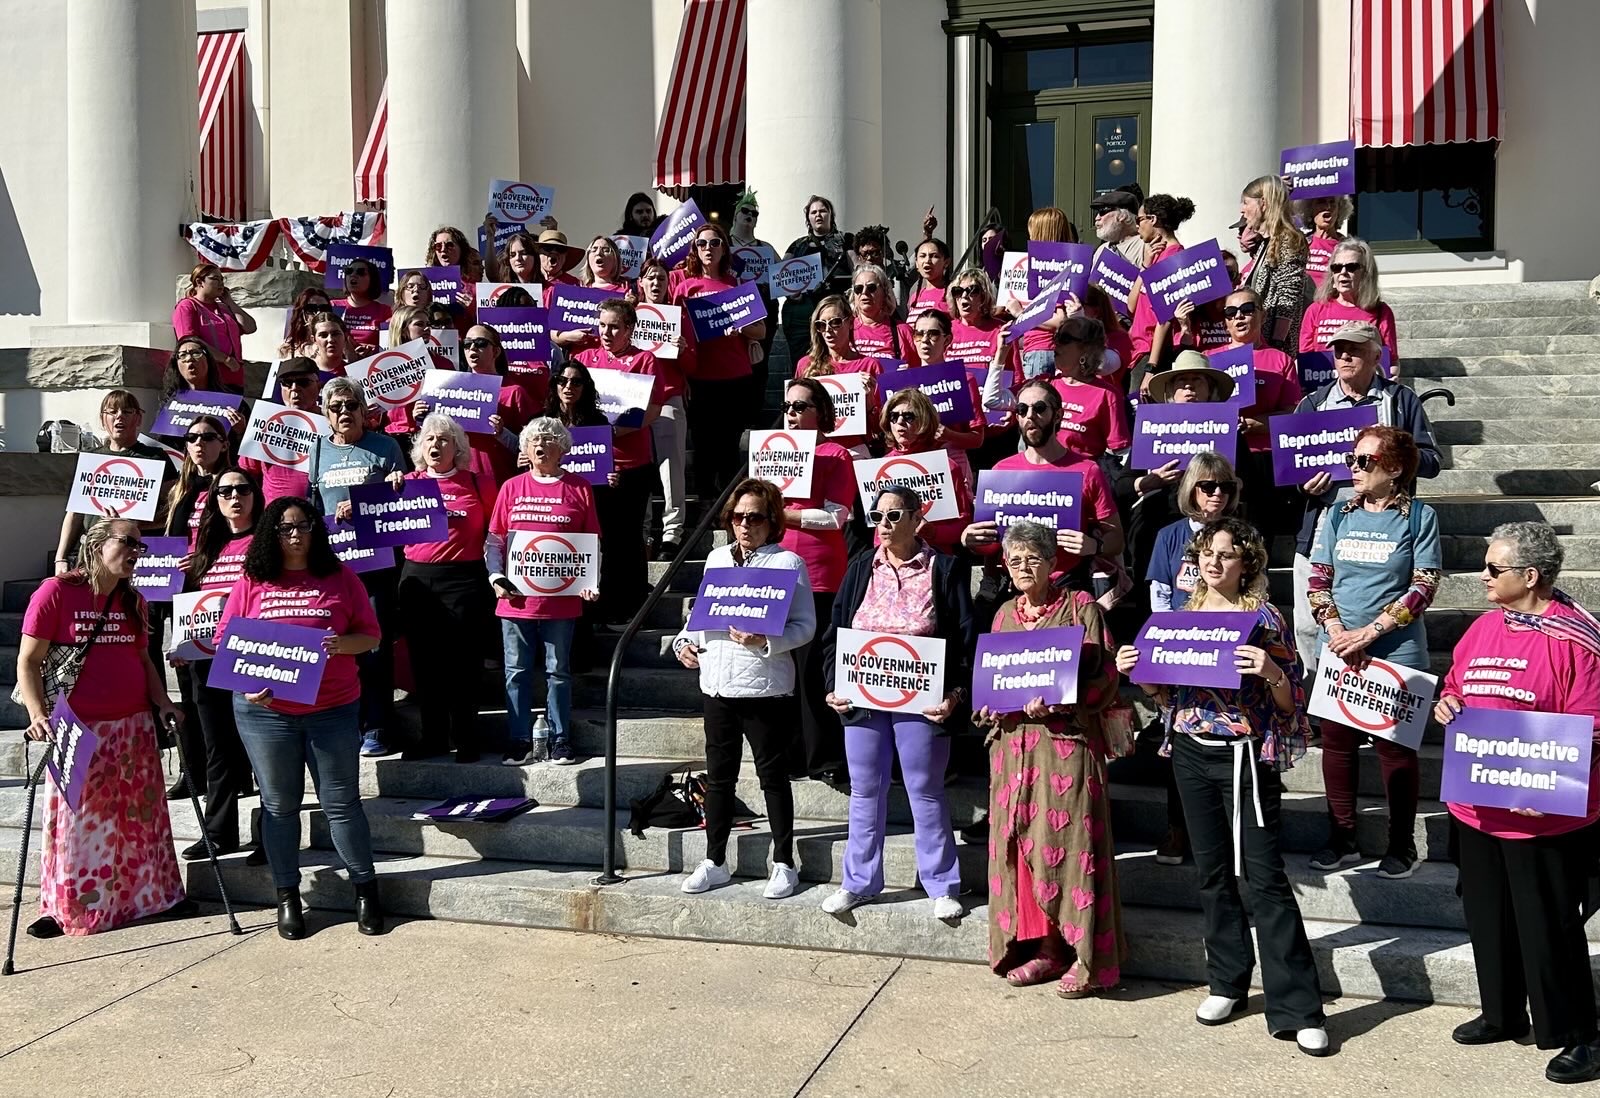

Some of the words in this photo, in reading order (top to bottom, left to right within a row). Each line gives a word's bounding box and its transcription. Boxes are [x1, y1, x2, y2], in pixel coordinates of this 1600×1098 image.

[1285, 156, 1348, 174] Reproductive
[1293, 173, 1338, 188] Freedom!
[492, 192, 502, 200] NO
[502, 193, 550, 204] GOVERNMENT
[494, 202, 544, 212] INTERFERENCE
[780, 264, 818, 278] GOVERNMENT
[1004, 270, 1011, 278] NO
[1150, 256, 1218, 294] Reproductive
[776, 273, 816, 288] INTERFERENCE
[1164, 276, 1212, 306] Freedom!
[694, 294, 756, 319] Reproductive
[708, 306, 751, 328] Freedom!
[502, 338, 536, 350] eedom!
[370, 356, 427, 384] GOVERNMENT
[1067, 402, 1084, 412] FOR
[253, 418, 266, 429] NO
[1142, 421, 1229, 436] Reproductive
[254, 432, 310, 454] INTERFEREN
[1153, 440, 1214, 454] Freedom!
[752, 452, 760, 462] NO
[760, 451, 809, 463] GOVERNMENT
[754, 466, 804, 477] INTERFERENCE
[80, 471, 93, 484] NO
[94, 473, 156, 490] GOVERNMENT
[864, 482, 876, 492] NO
[82, 485, 148, 502] INTERFERENCE
[984, 490, 1073, 507] Reproductive
[359, 496, 438, 517] Reproductive
[374, 515, 431, 534] Freedom!
[511, 514, 571, 523] PARENTHOOD
[1346, 530, 1370, 538] JEWS
[1337, 540, 1396, 551] ABORTION
[511, 551, 522, 562] NO
[524, 552, 592, 564] GOVERNMENT
[1340, 551, 1387, 560] JUSTICE
[515, 565, 586, 577] INTERFERENCE
[704, 584, 786, 600] Reproductive
[260, 600, 309, 608] PLANNED
[708, 602, 768, 618] Freedom!
[179, 614, 191, 626] NO
[259, 609, 331, 619] PARENTHOOD
[1144, 626, 1241, 642] Reproductive
[227, 635, 319, 664] Reproductive
[1151, 647, 1218, 666] Freedom!
[842, 653, 857, 666] NO
[859, 656, 937, 675] GOVERNMENT
[982, 647, 1072, 669] Reproductive
[1504, 658, 1528, 669] FOR
[233, 658, 299, 683] Freedom!
[1464, 670, 1512, 680] PLANNED
[847, 670, 930, 691] INTERFERENCE
[992, 670, 1054, 690] Freedom!
[1324, 667, 1340, 682] NO
[1343, 673, 1425, 709] GOVERNMENT
[1462, 684, 1536, 701] PARENTHOOD
[1327, 684, 1414, 724] INTERFERENCE
[1455, 732, 1579, 762] Reproductive
[1471, 764, 1557, 790] Freedom!
